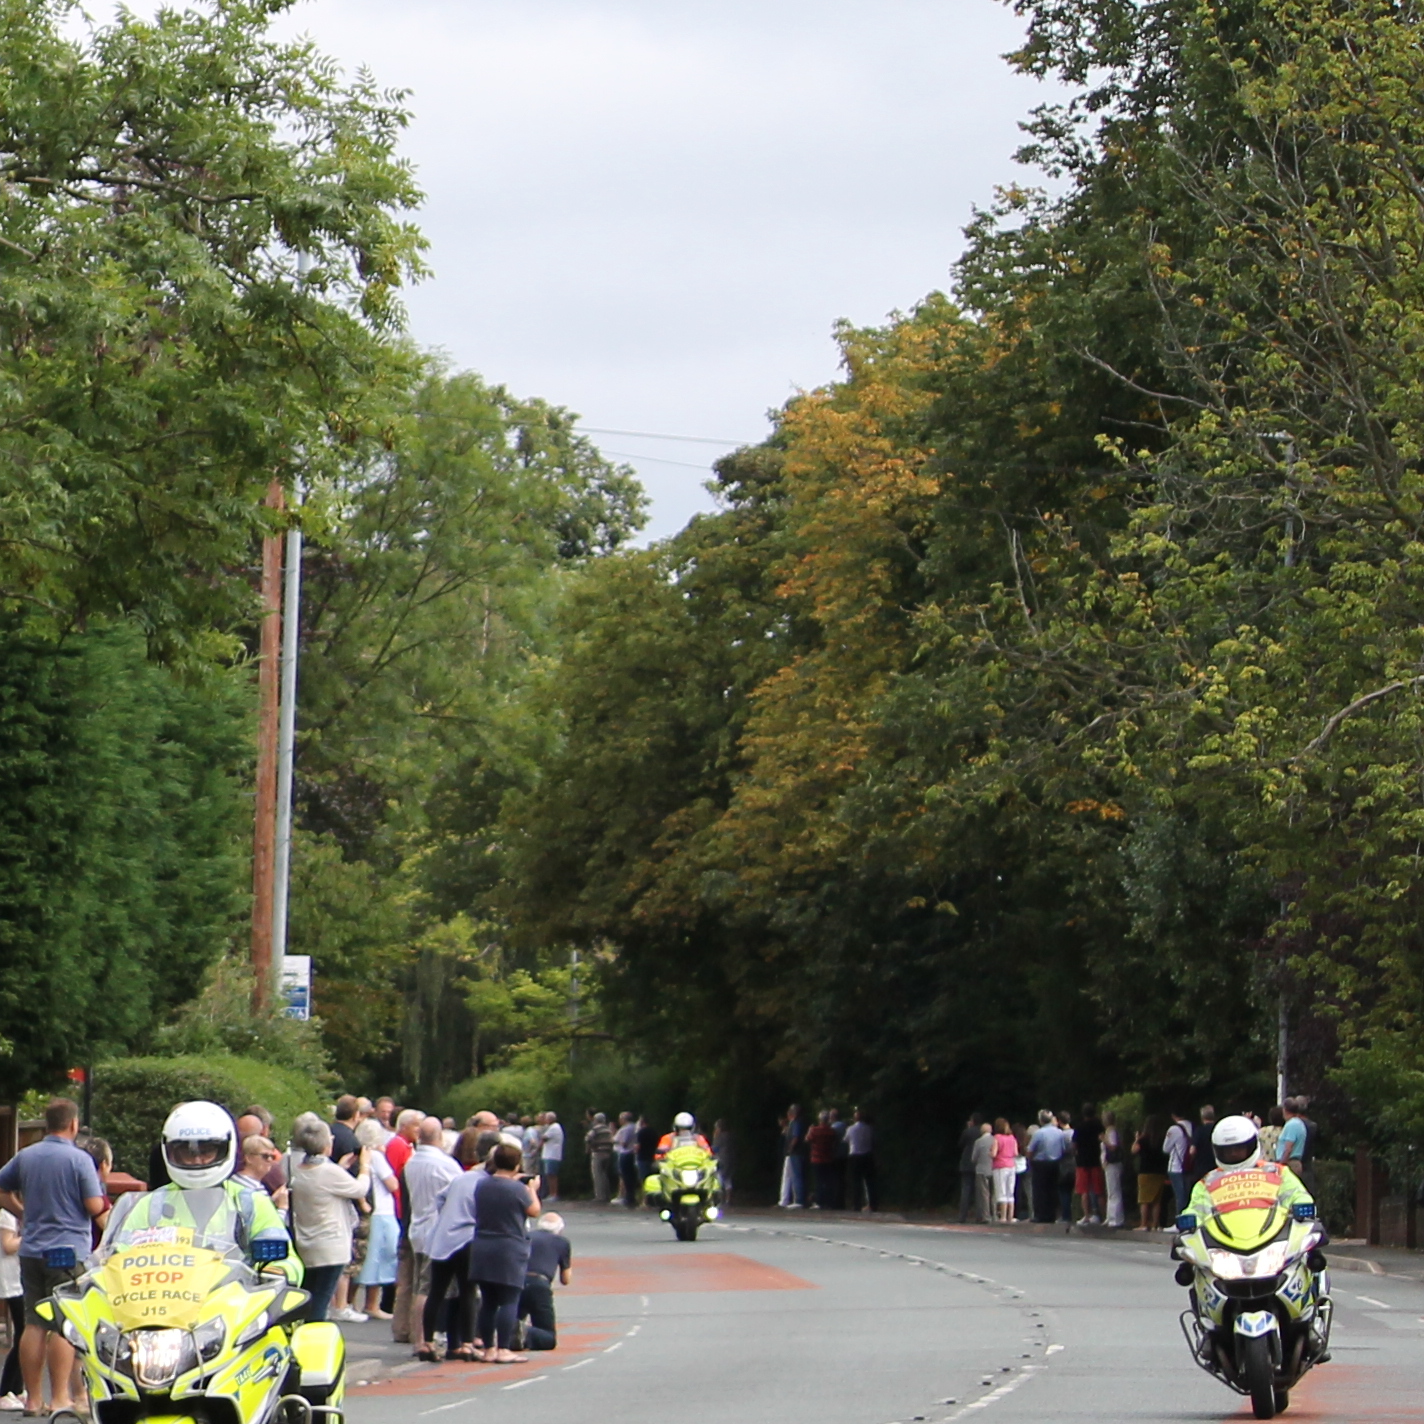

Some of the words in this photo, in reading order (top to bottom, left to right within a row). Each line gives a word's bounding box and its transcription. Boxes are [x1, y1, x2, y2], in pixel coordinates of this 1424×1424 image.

[179, 1128, 211, 1136] POLICE
[1220, 1173, 1267, 1186] POLICE
[1227, 1181, 1261, 1191] STOP
[122, 1254, 195, 1270] POLICE
[130, 1271, 184, 1286] STOP
[113, 1290, 157, 1306] CYCLE
[161, 1290, 201, 1303] RACE
[141, 1306, 167, 1317] J15
